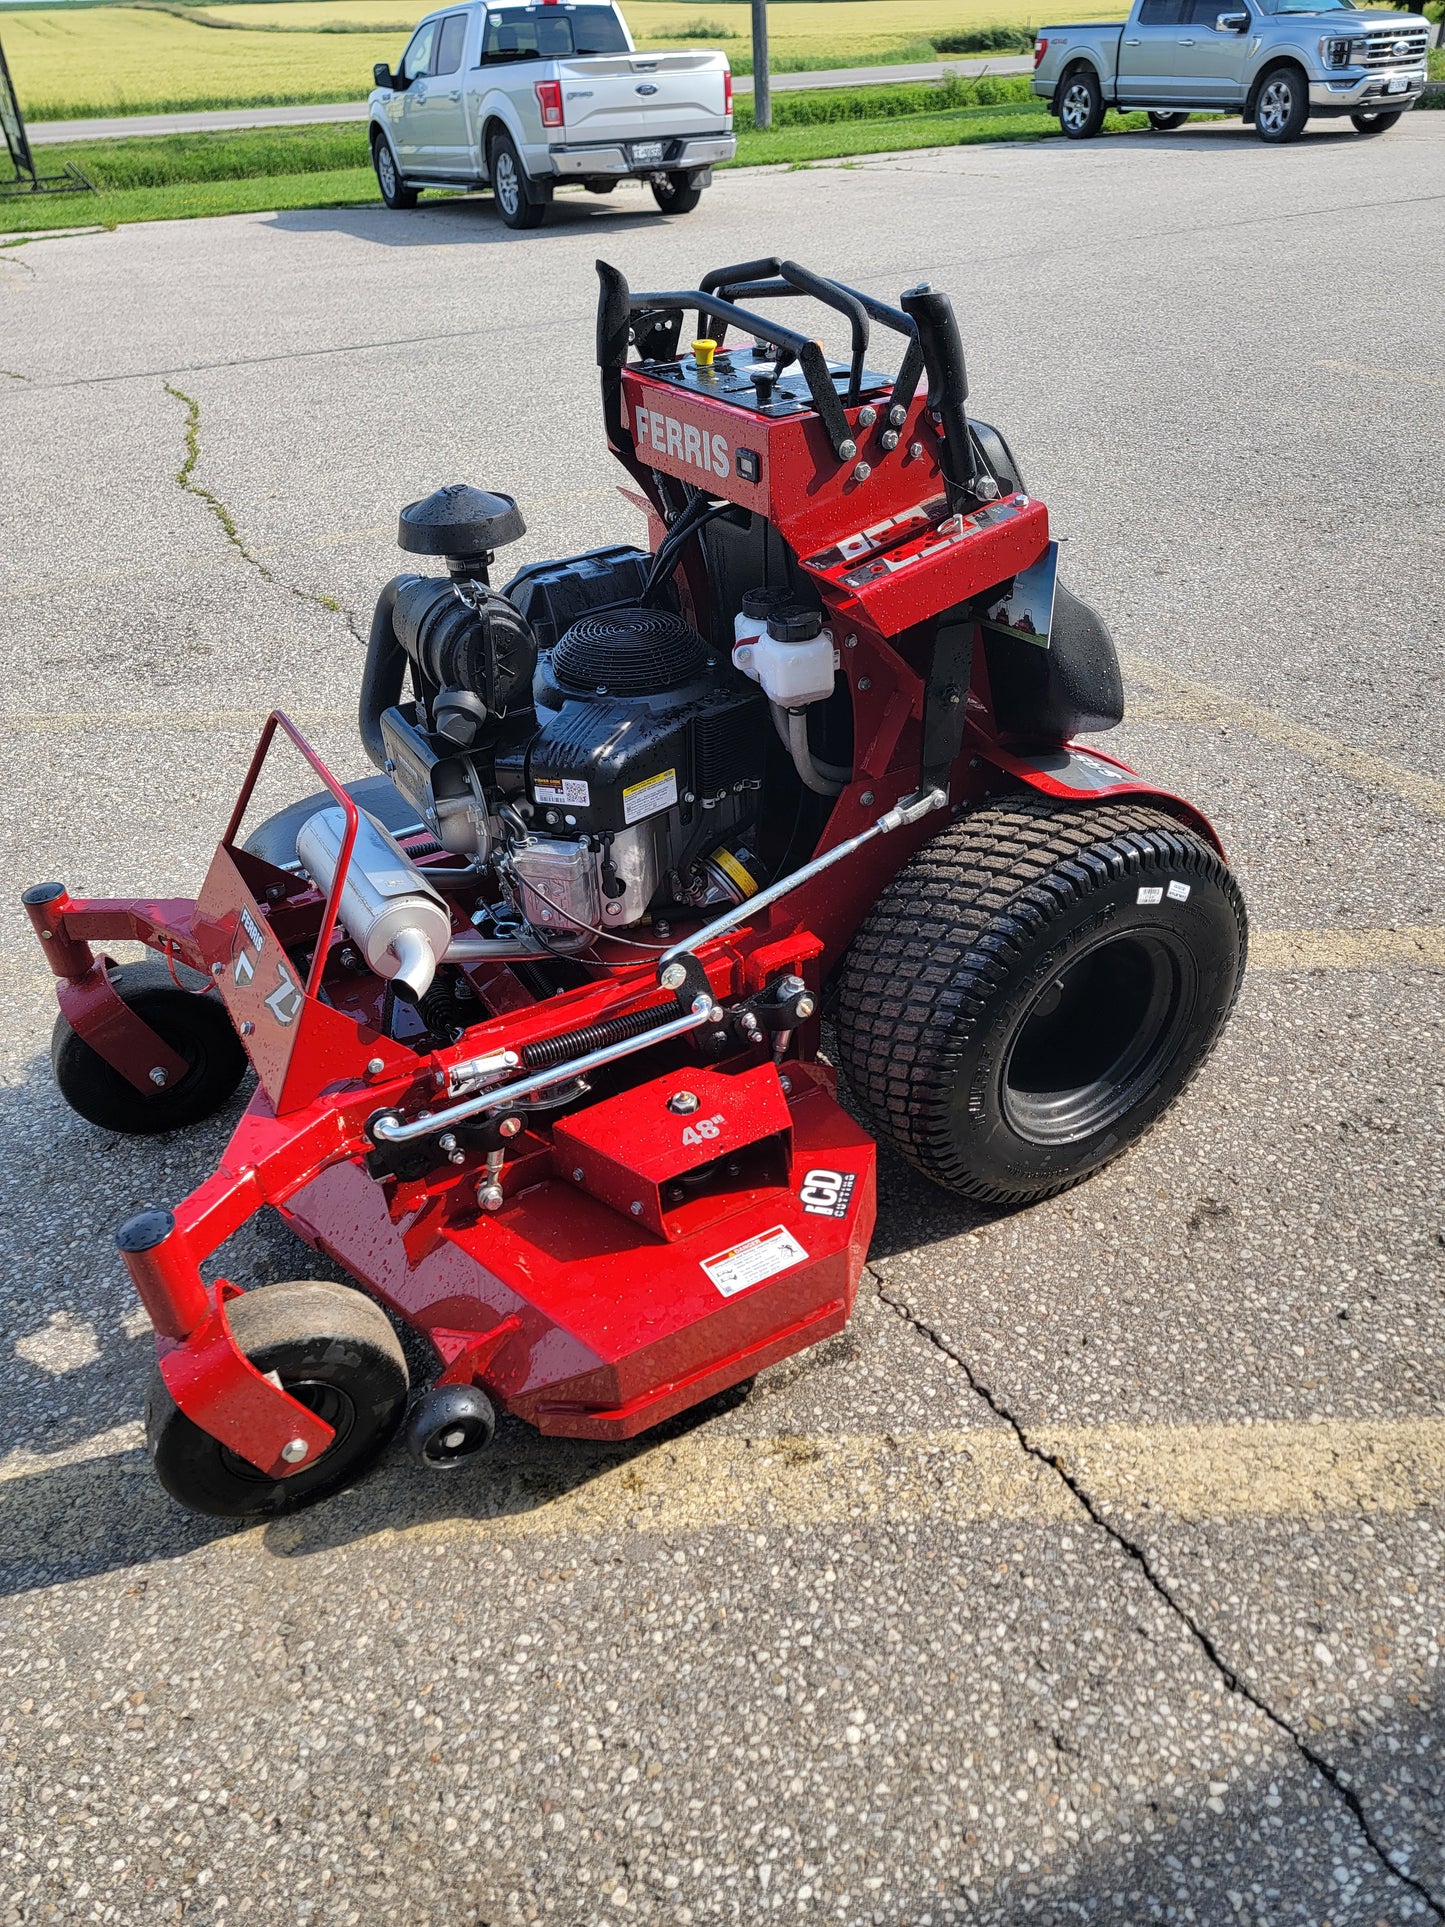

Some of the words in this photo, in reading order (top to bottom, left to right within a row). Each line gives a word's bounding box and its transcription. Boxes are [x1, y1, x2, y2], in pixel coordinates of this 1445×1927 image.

[635, 405, 730, 478] FERRIS
[241, 908, 264, 952] FERRIS
[734, 1238, 762, 1255] DANGER
